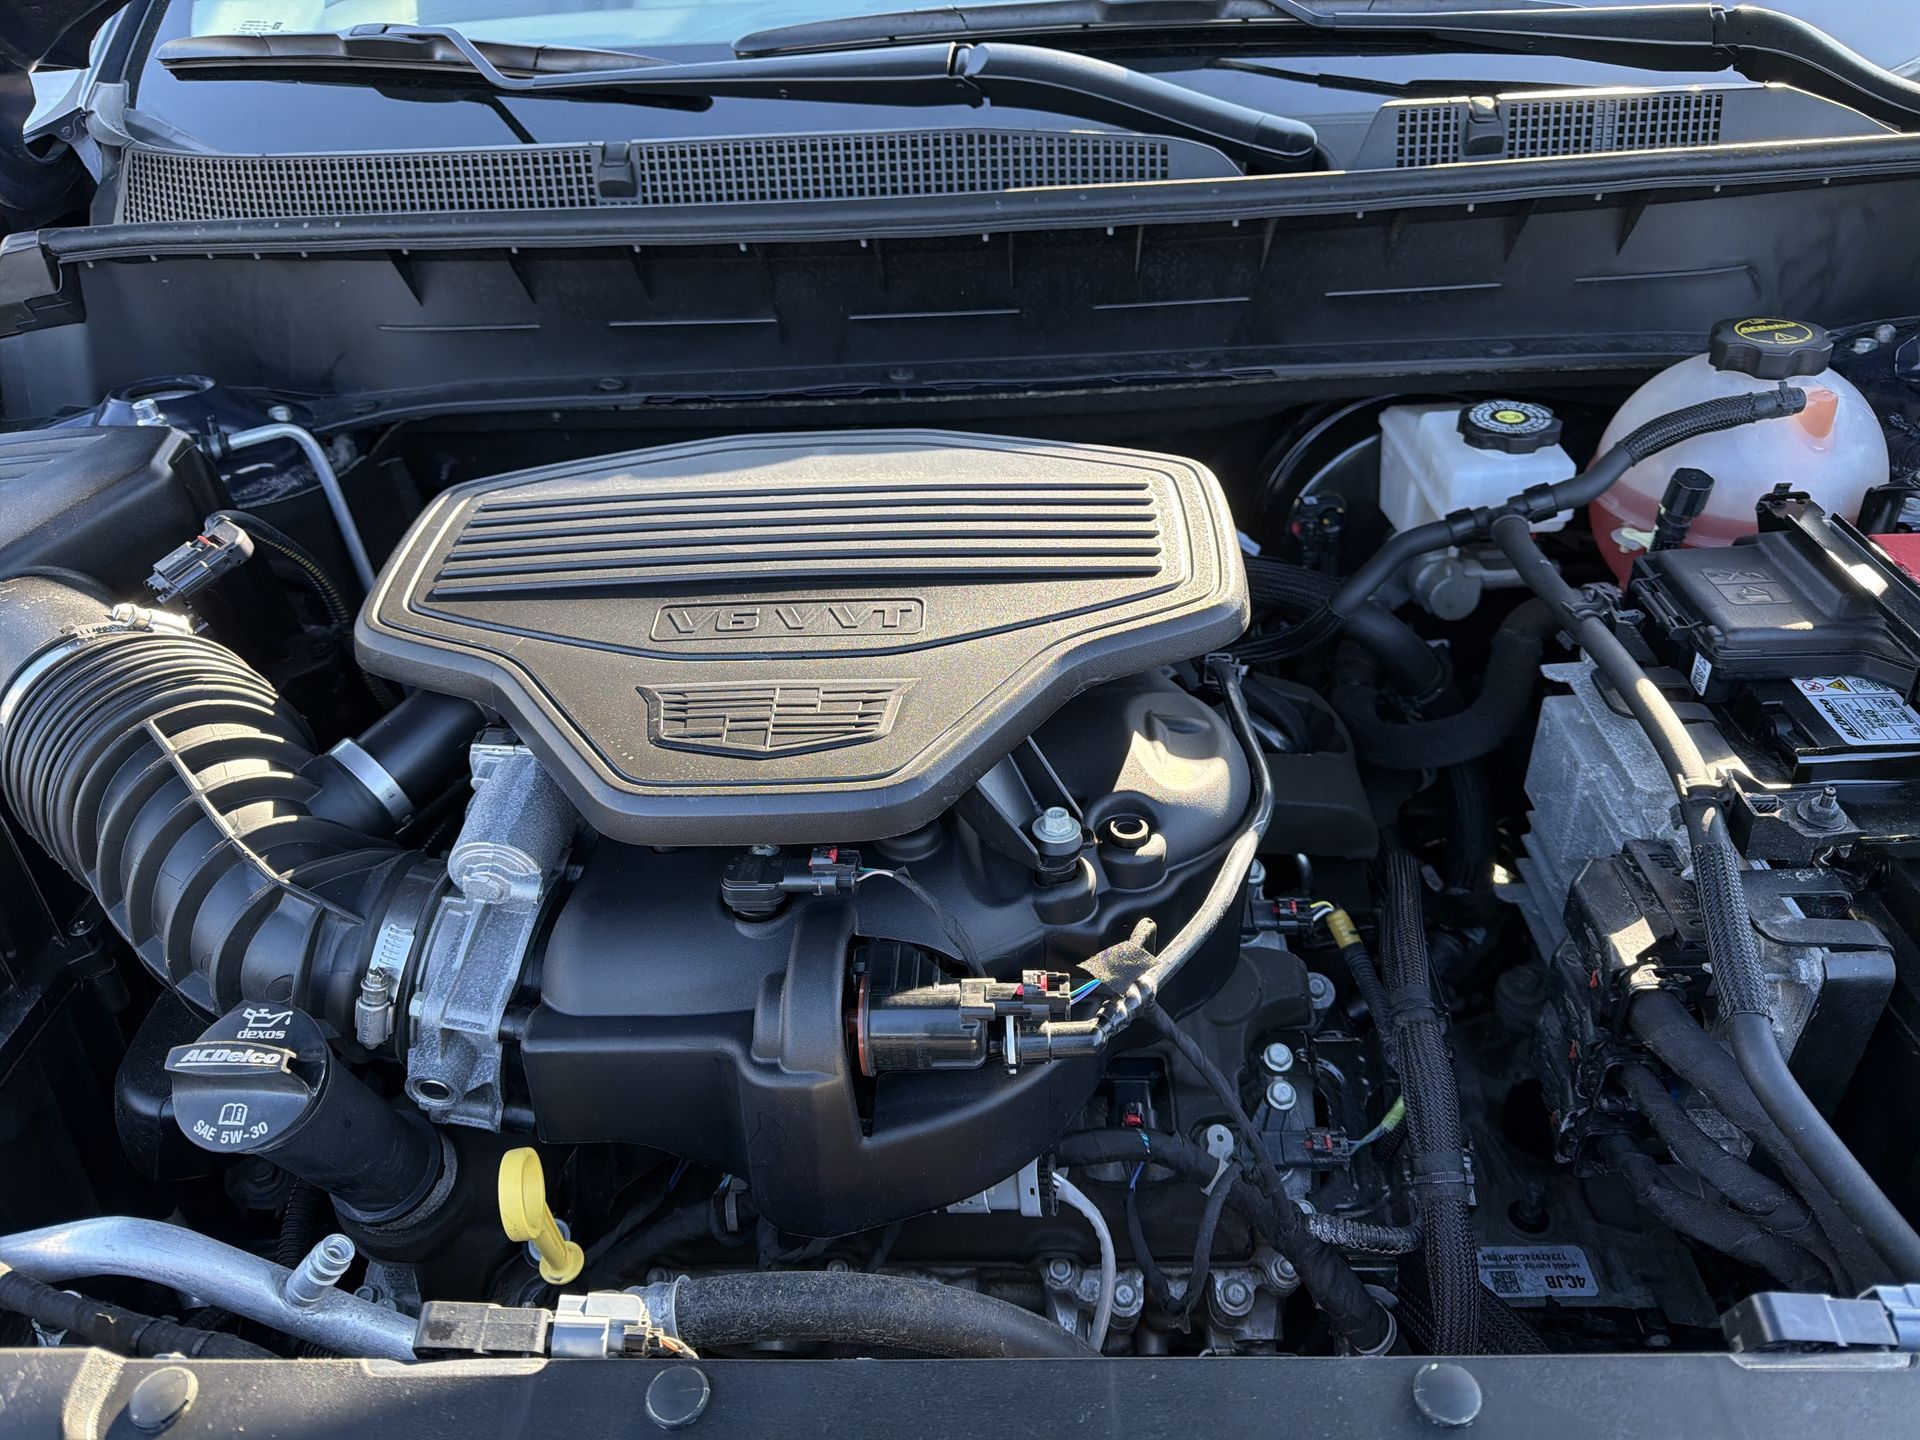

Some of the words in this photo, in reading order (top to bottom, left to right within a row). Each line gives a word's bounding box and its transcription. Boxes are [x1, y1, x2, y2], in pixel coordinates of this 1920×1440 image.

[667, 607, 760, 633] V6
[775, 603, 914, 629] VVT
[1819, 698, 1862, 740] ACDelco
[236, 1028, 286, 1039] dexos
[180, 1049, 281, 1064] ACDelco
[192, 1120, 217, 1141] SAE
[220, 1121, 268, 1144] 5W-30
[1545, 1275, 1586, 1288] 4CJB
